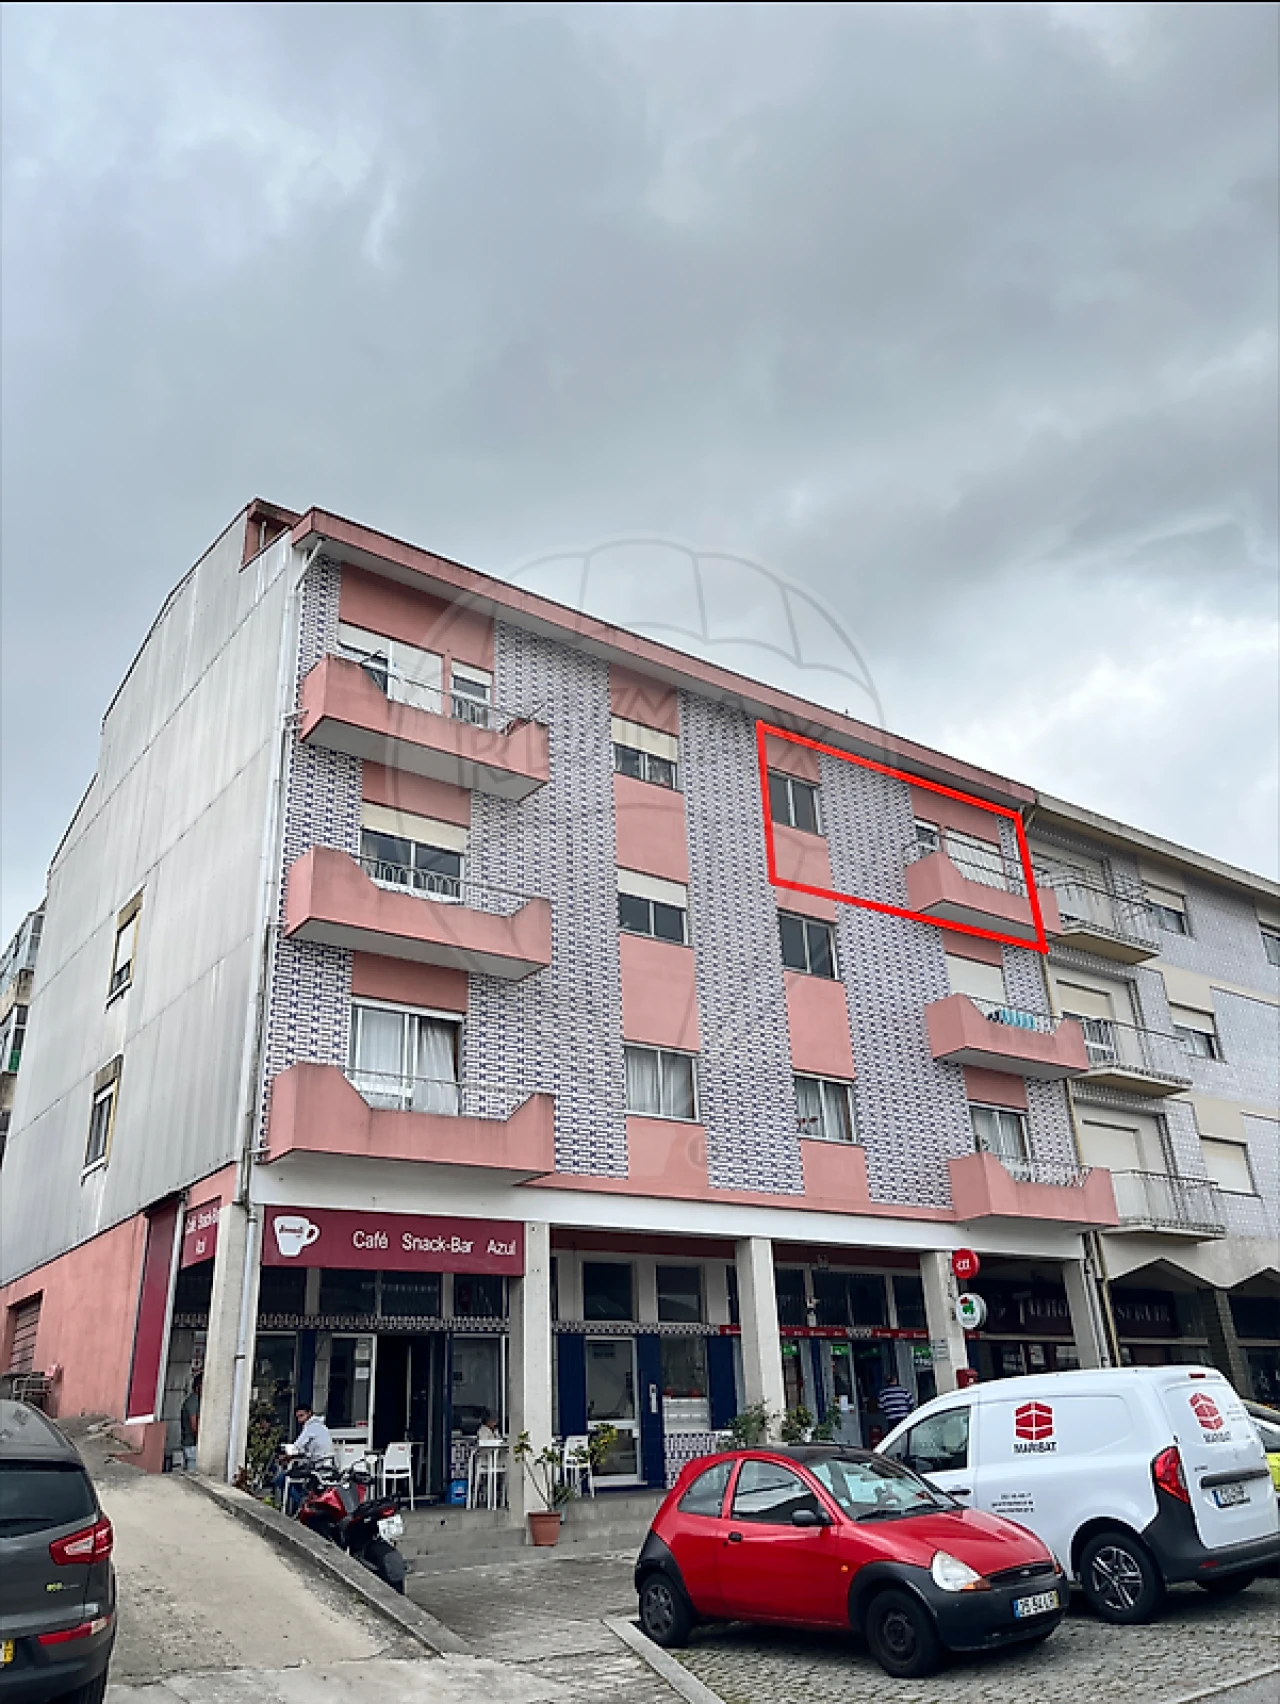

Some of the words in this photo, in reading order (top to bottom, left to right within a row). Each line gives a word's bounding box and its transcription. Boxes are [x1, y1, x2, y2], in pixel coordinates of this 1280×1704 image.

[352, 1230, 389, 1249] Café
[401, 1232, 474, 1253] Snack-Bar
[487, 1239, 517, 1256] Azul
